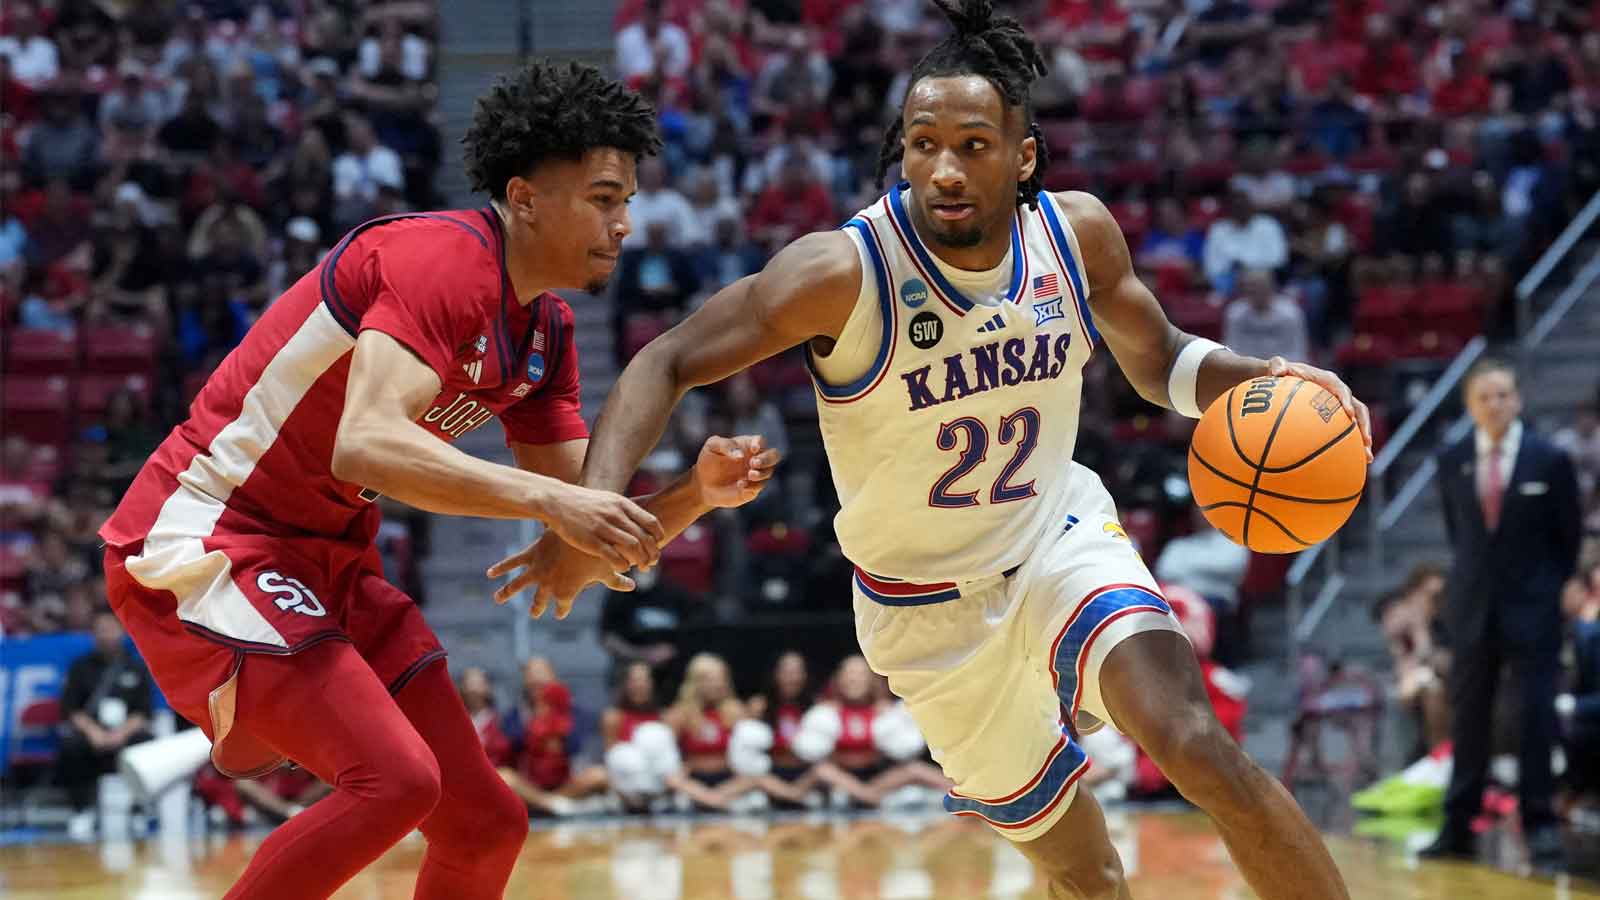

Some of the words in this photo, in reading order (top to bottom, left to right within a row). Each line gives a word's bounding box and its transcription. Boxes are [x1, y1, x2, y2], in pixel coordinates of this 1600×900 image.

[912, 319, 938, 342] SW
[900, 332, 1071, 411] KANSAS
[928, 406, 1041, 508] 22
